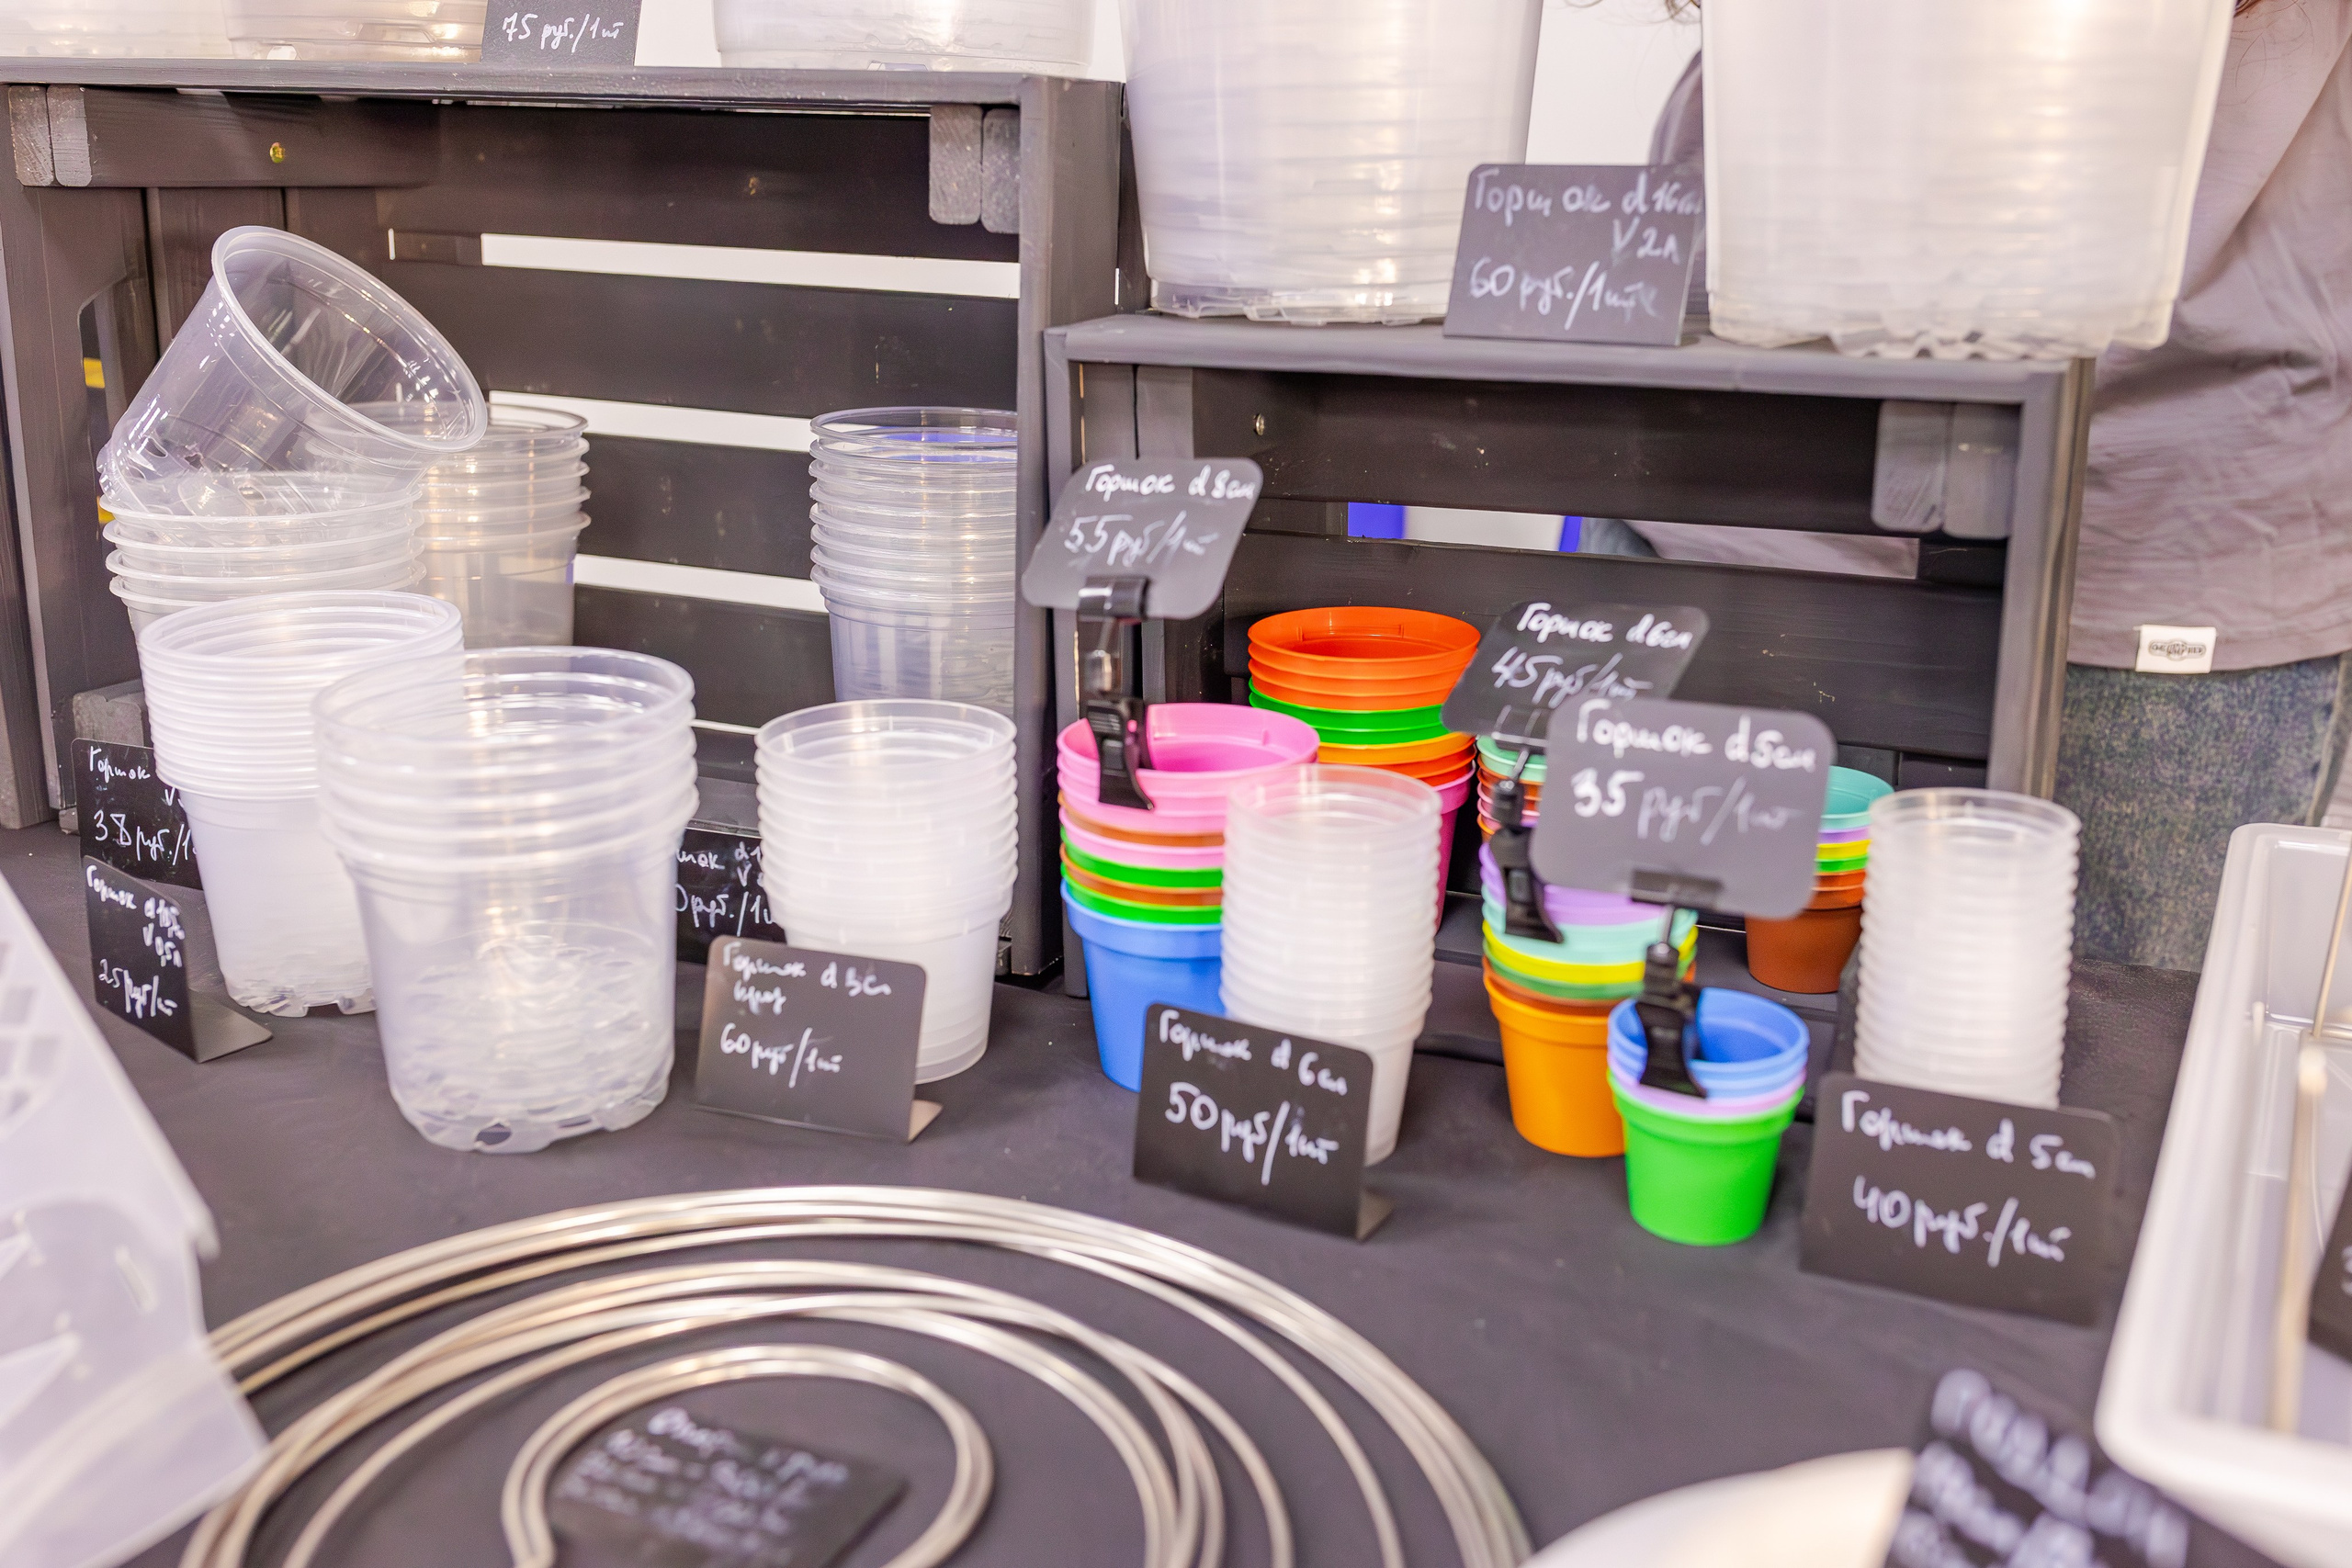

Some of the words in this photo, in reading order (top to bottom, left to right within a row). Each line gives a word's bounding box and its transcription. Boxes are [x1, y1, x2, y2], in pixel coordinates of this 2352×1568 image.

[502, 12, 538, 42] 75
[1085, 463, 1176, 502] Горшок
[1516, 602, 1614, 644] Горшок
[1576, 697, 1713, 759] Горшок
[89, 745, 151, 784] Горшок
[675, 849, 725, 870] шок
